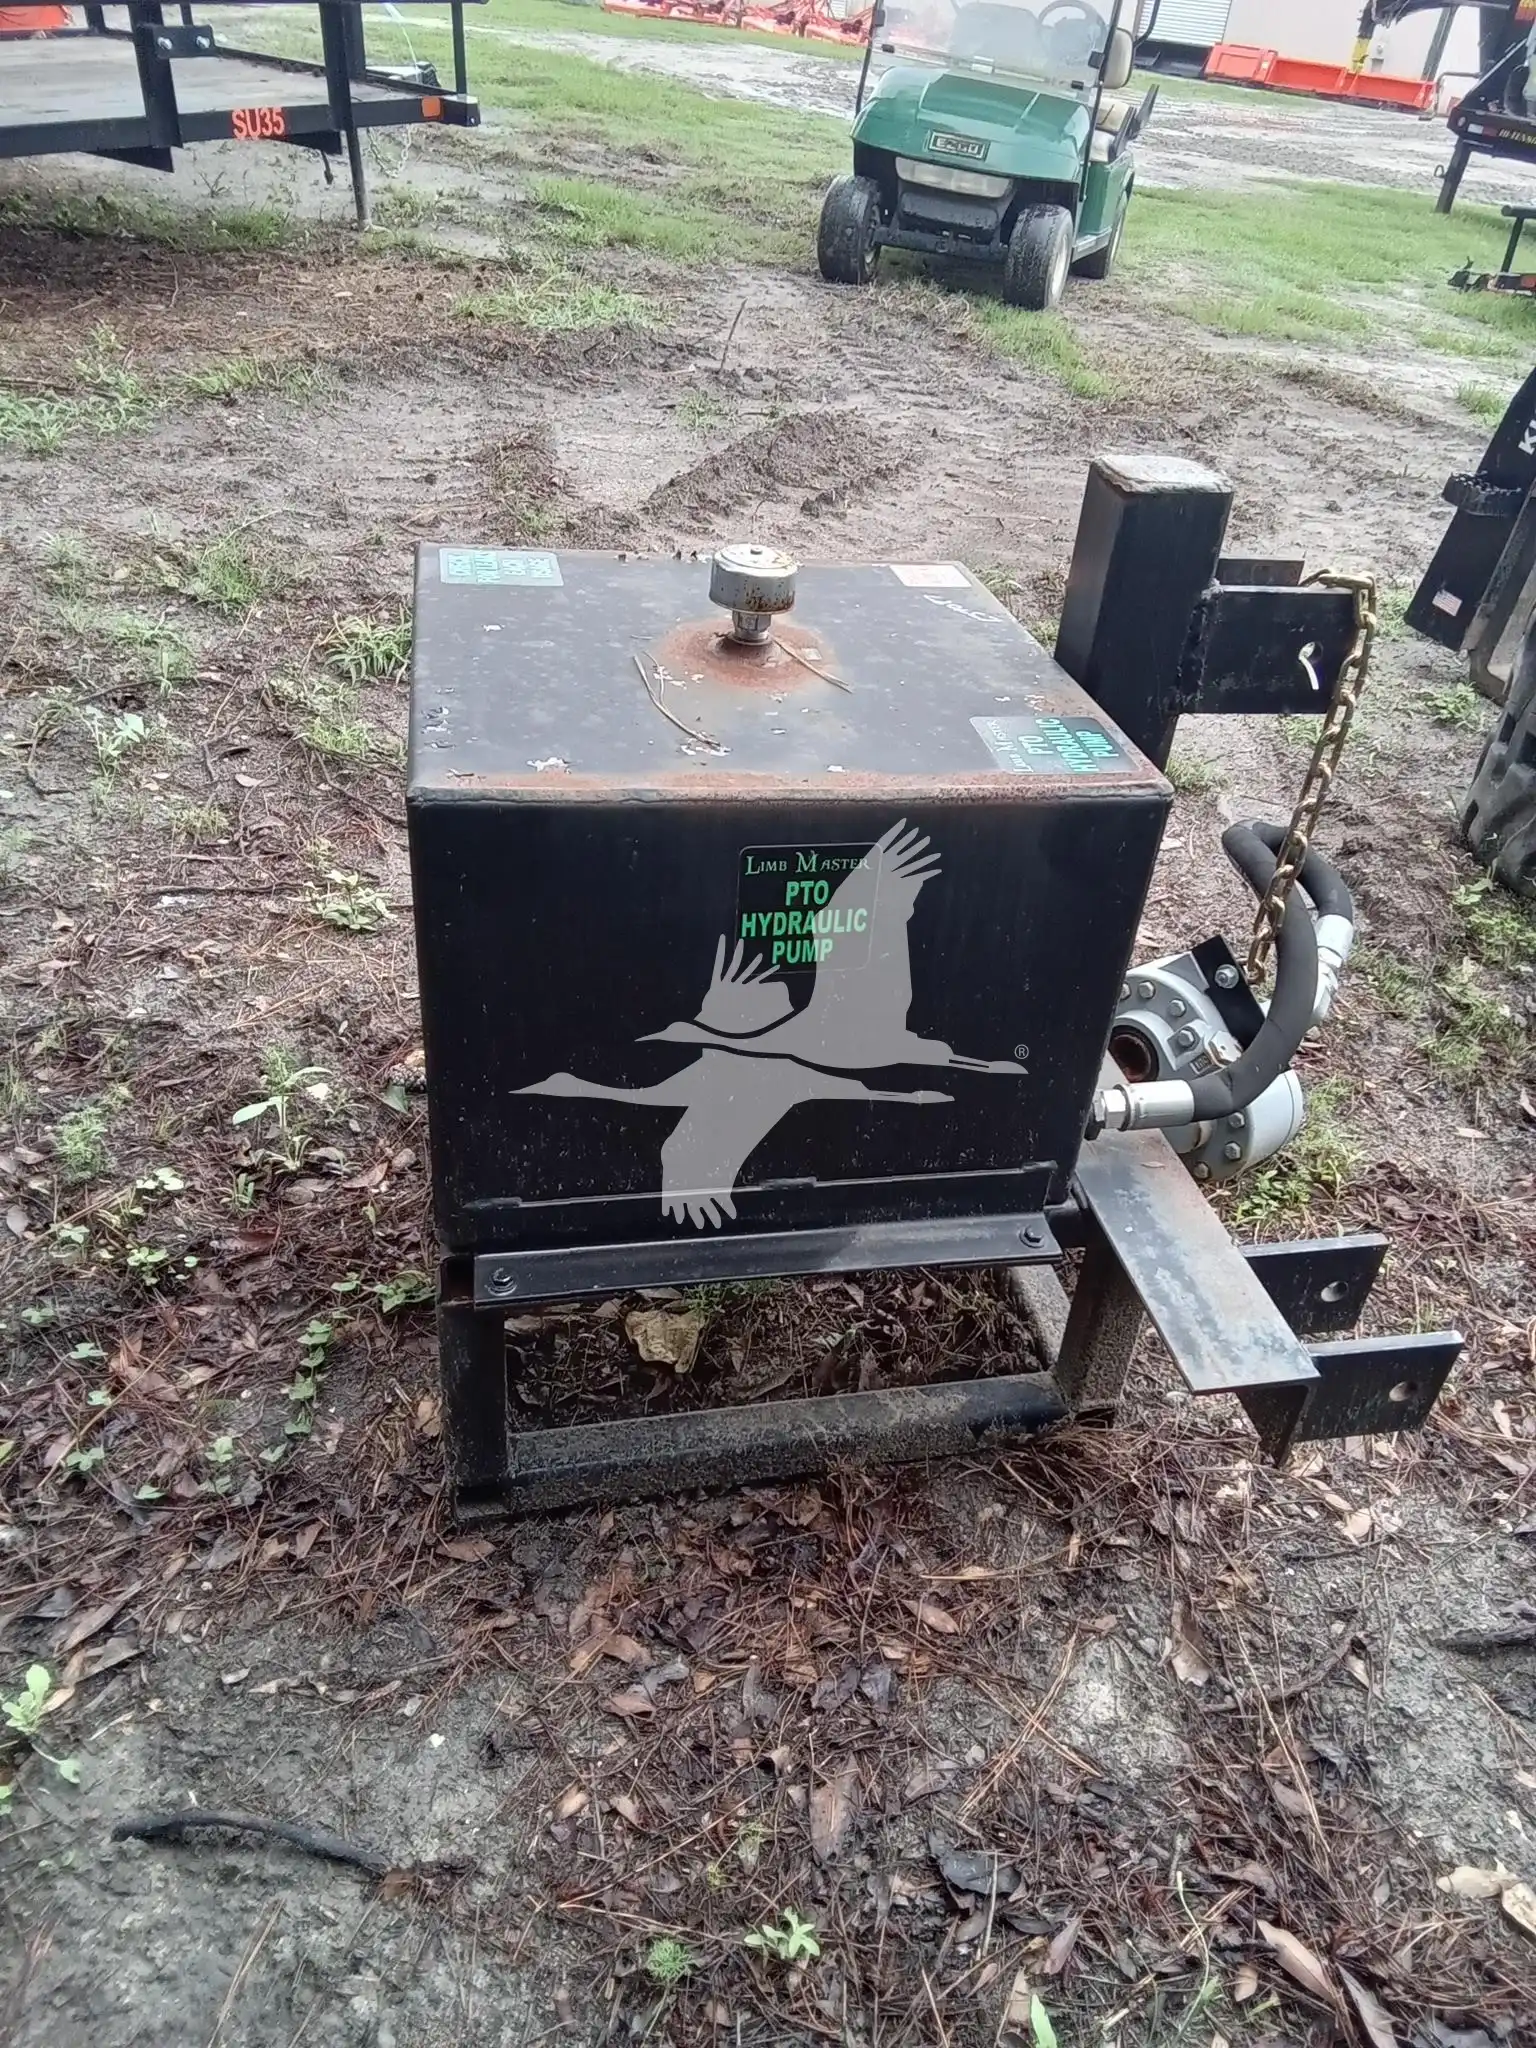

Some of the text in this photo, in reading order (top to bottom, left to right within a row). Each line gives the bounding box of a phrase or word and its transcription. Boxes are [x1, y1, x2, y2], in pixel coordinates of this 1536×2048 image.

[232, 106, 285, 140] SU35
[1018, 735, 1054, 755] PTO
[1035, 718, 1100, 772] HYDRAULIC
[1075, 730, 1119, 758] PUMP
[745, 849, 872, 875] LIMB MASTER
[785, 880, 829, 906] PTO
[741, 908, 868, 937] HYDRAULIC
[772, 938, 833, 964] PUMP
